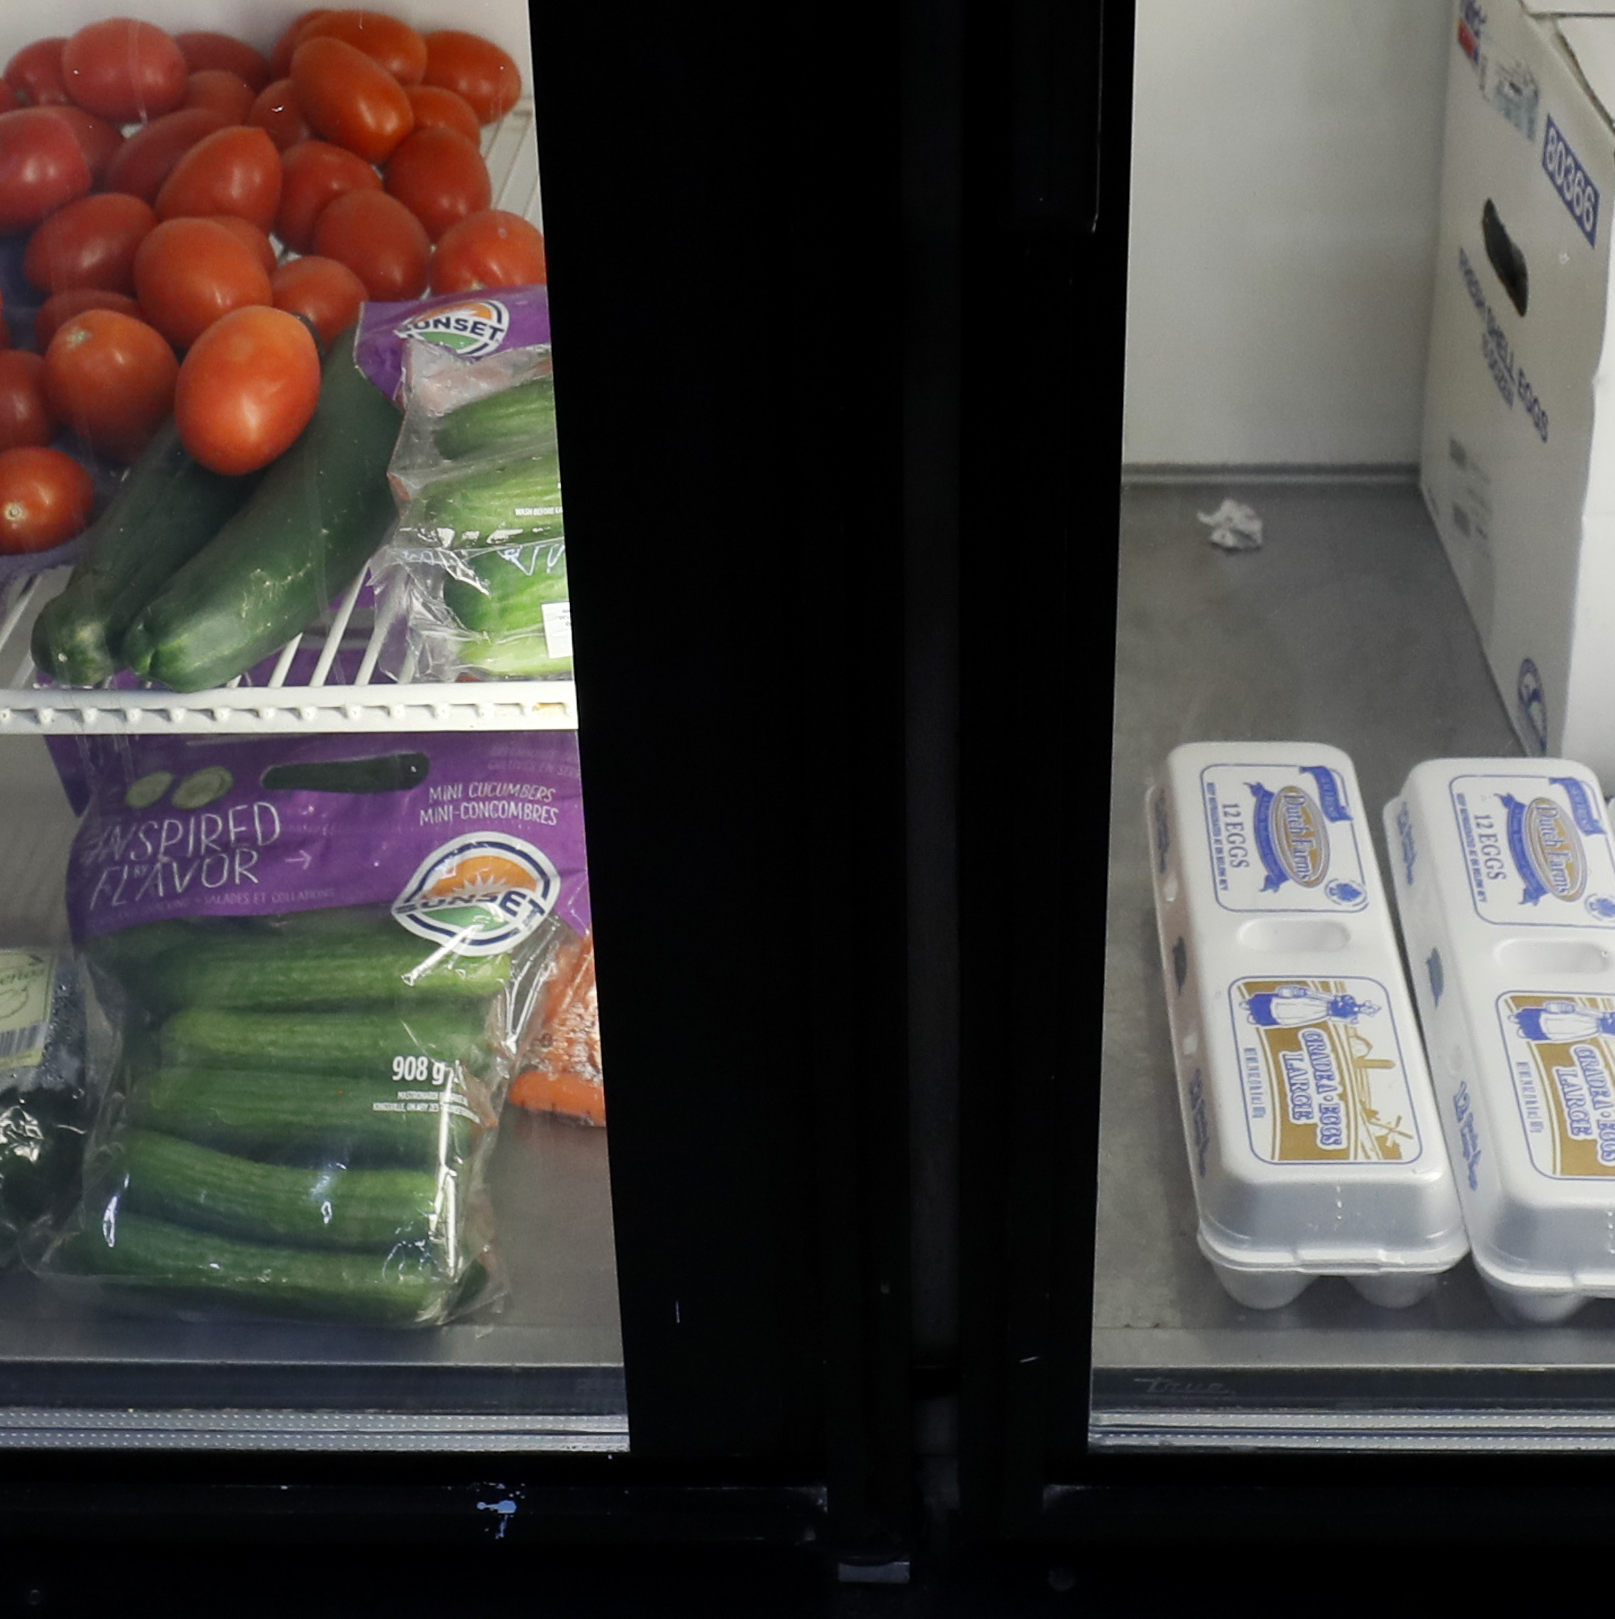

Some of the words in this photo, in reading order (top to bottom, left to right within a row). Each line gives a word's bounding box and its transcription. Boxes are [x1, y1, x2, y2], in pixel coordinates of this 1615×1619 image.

[1545, 129, 1595, 233] 80366
[420, 800, 559, 826] MINI-CONCOMBRES
[429, 784, 463, 804] MINI
[469, 782, 557, 803] CUCUMBERS
[1222, 802, 1241, 819] 12
[1283, 794, 1307, 836] Dutch
[85, 801, 282, 864] INSPIRED
[1473, 814, 1495, 831] 12
[1535, 805, 1565, 848] Dutch
[1224, 822, 1250, 869] EGGS
[1291, 838, 1315, 881] Farms
[1478, 833, 1507, 881] EGGS
[89, 848, 260, 910] FLAVOR
[1547, 851, 1572, 896] Farms
[204, 890, 251, 906] SALADES
[253, 892, 266, 904] ET
[394, 889, 547, 927] SUNSET
[392, 1056, 429, 1082] 908
[1301, 1030, 1337, 1084] GRADE
[1282, 1052, 1315, 1122] LARGE
[1555, 1067, 1594, 1137] LARGE
[1318, 1102, 1343, 1147] EGGS
